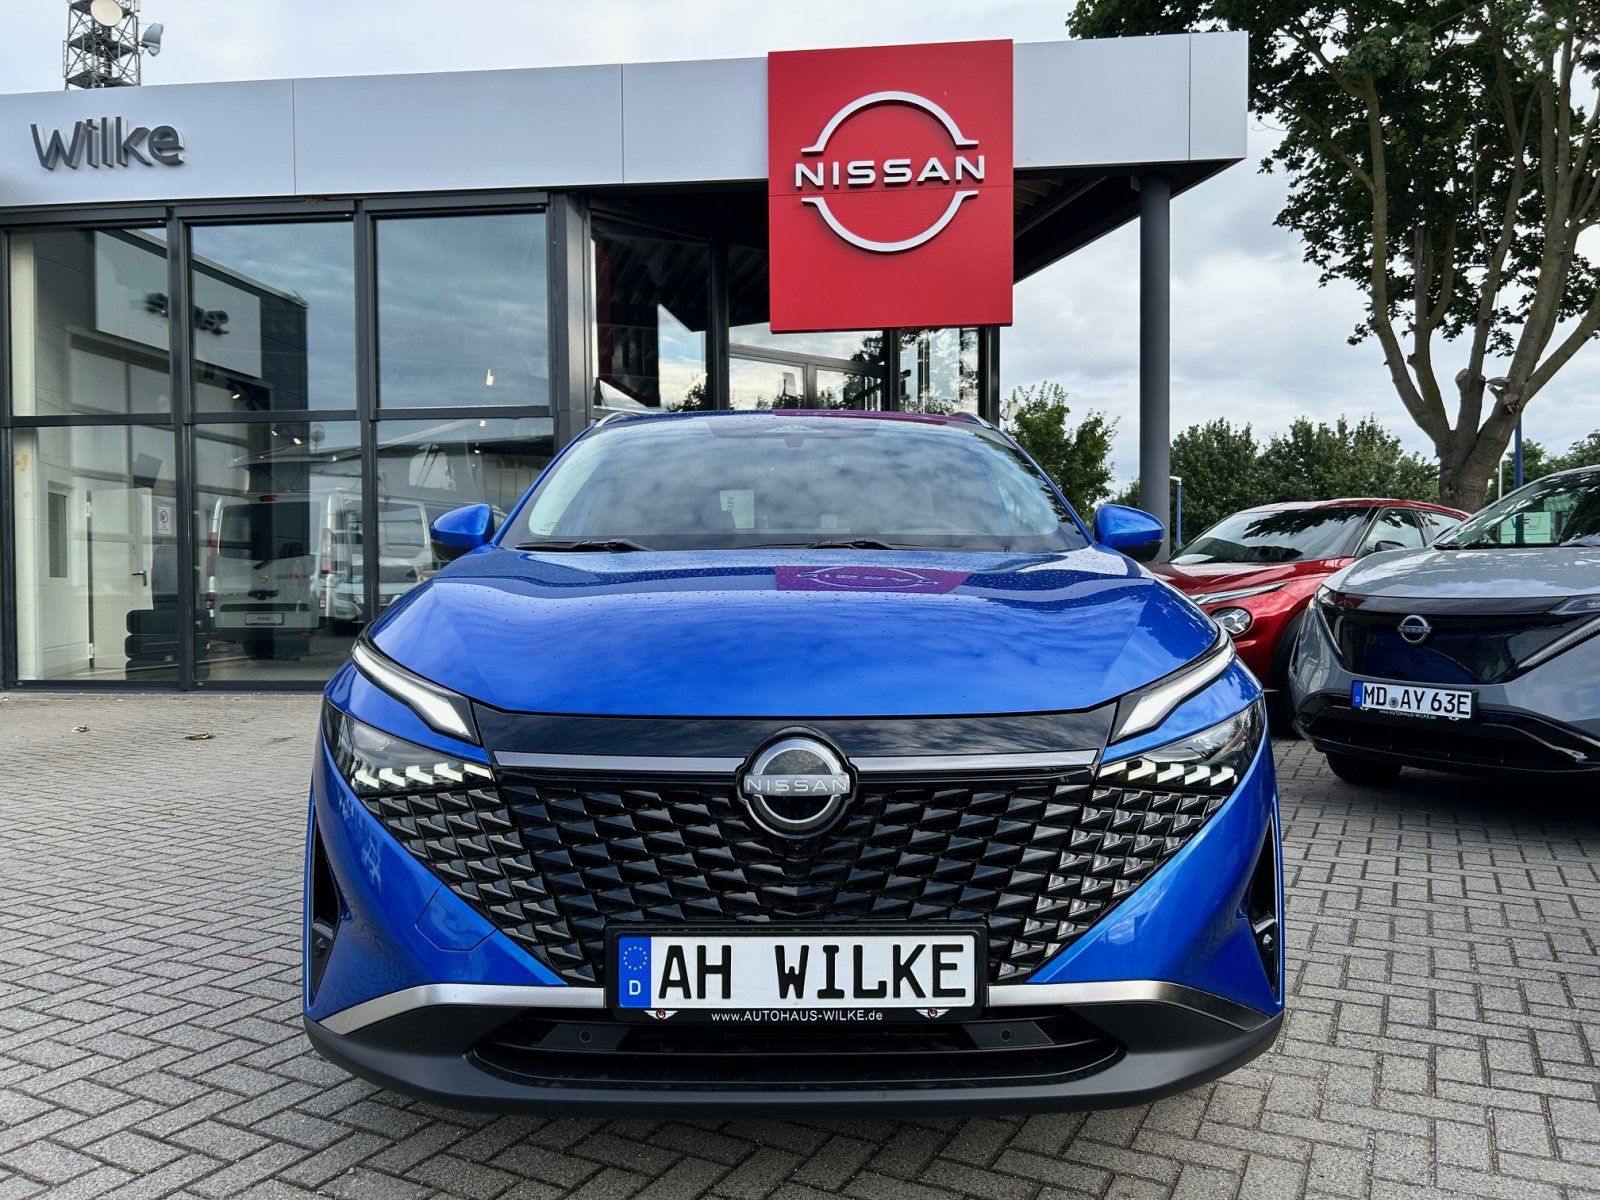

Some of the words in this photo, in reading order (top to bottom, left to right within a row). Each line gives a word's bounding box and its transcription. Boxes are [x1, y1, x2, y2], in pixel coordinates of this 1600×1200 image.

[30, 116, 185, 170] Wilke
[795, 154, 986, 189] NISSAN
[1363, 685, 1388, 706] MD
[1400, 689, 1426, 710] AY
[1430, 692, 1470, 716] 63E
[746, 778, 849, 792] NISSAN
[657, 944, 732, 1000] AH
[774, 943, 967, 1000] WILKE
[628, 979, 642, 996] D
[711, 1010, 884, 1022] www.AUTOHAUS-WILKE.de
